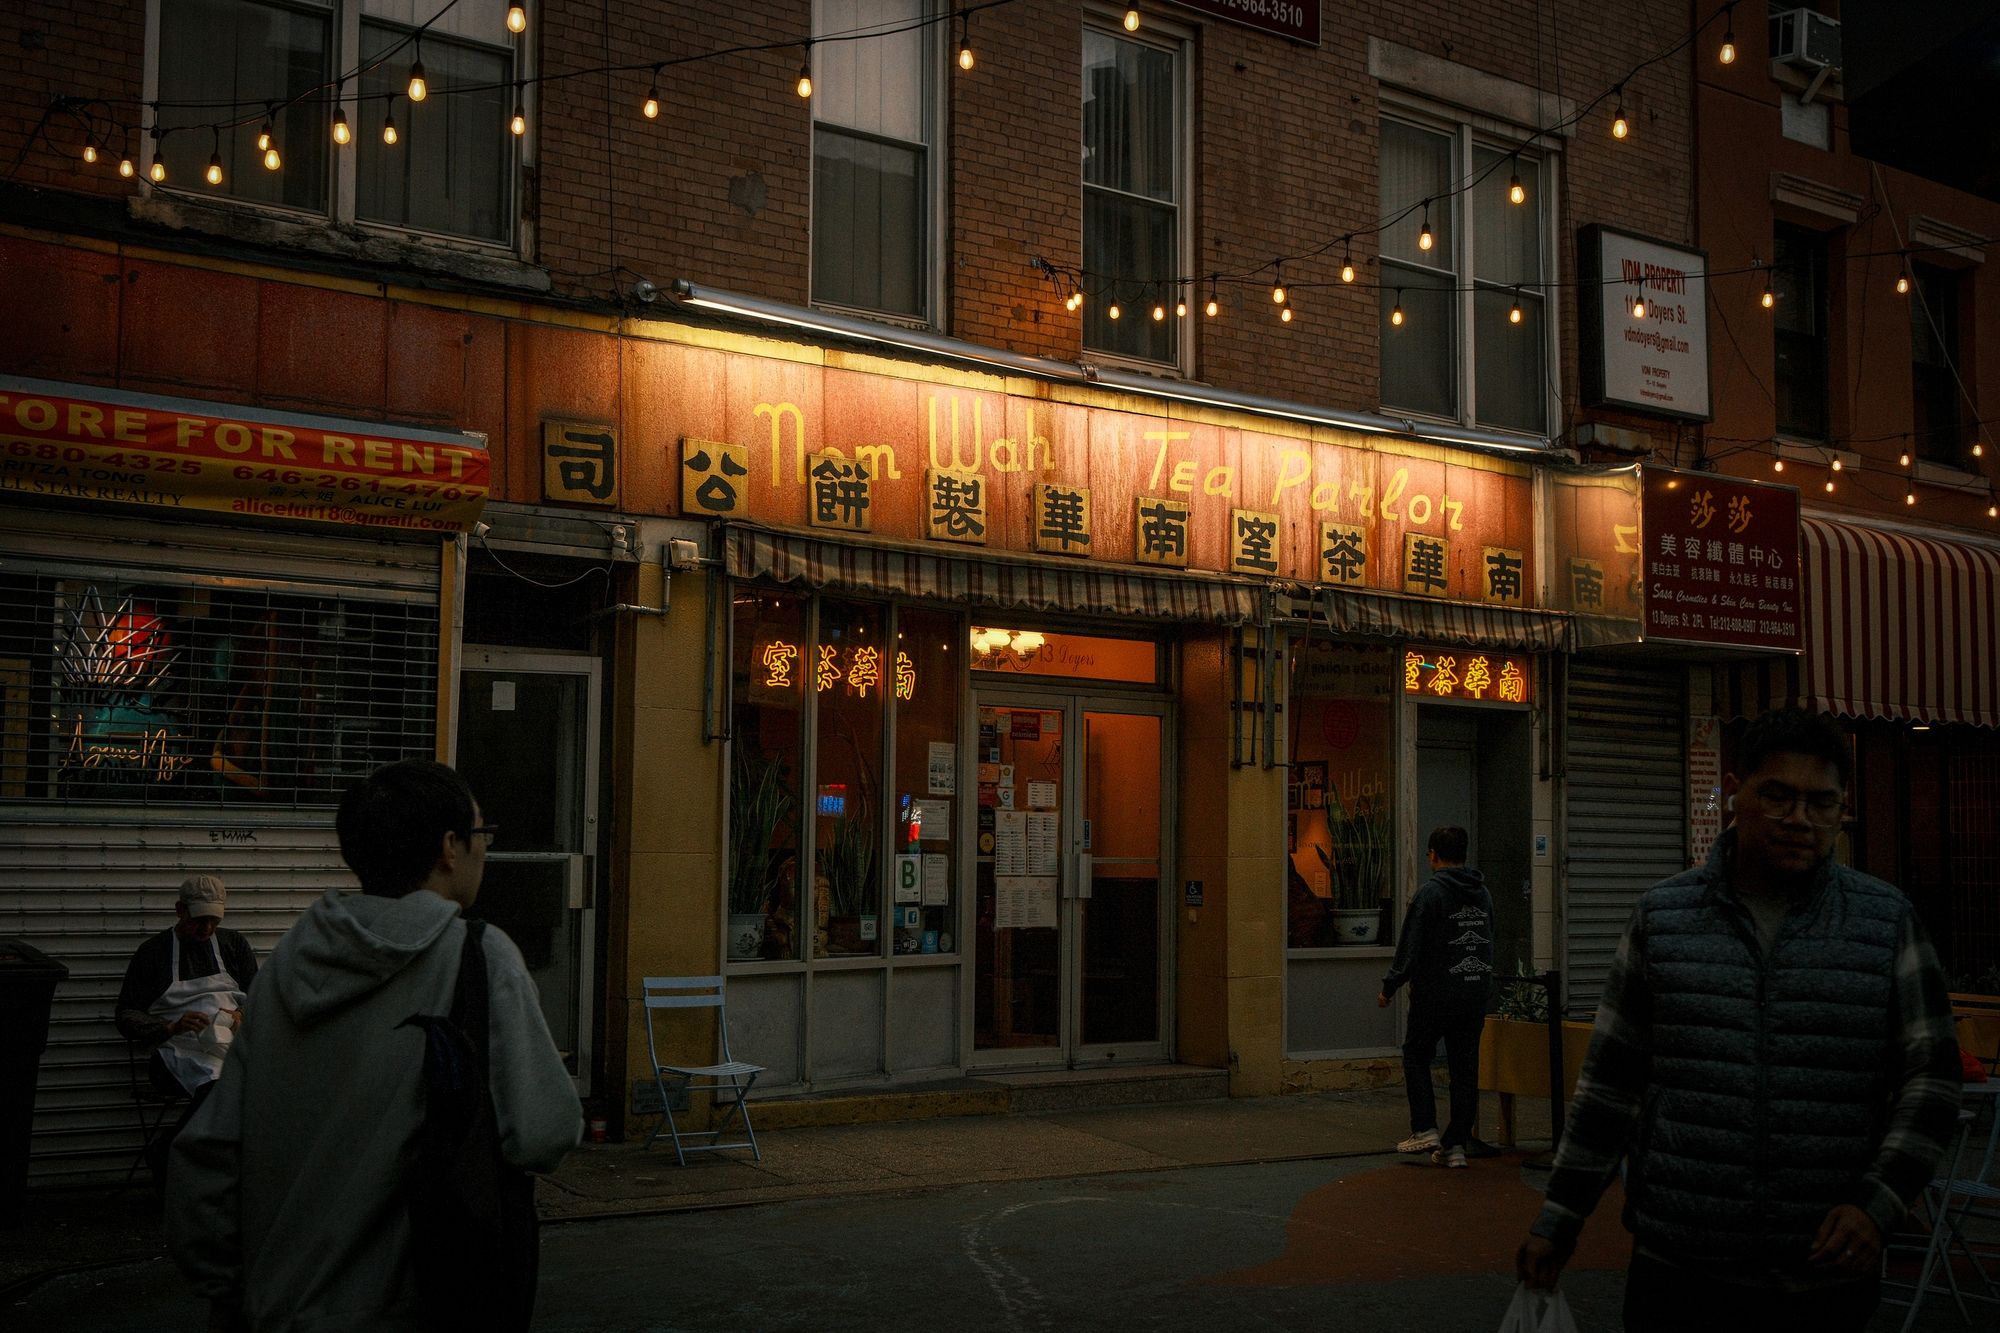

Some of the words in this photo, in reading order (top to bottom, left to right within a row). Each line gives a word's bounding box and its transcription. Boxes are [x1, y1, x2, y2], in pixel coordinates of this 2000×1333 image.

[1622, 258, 1641, 286] VDM
[1644, 263, 1686, 296] PROPERTY
[1649, 299, 1675, 325] Doyers
[1677, 305, 1688, 325] St.
[0, 396, 148, 443] ORE
[177, 417, 298, 461] FOR
[323, 435, 473, 479] RENT
[0, 459, 70, 477] RITZA
[80, 466, 147, 485] TONG
[929, 396, 1056, 474] Wah
[1143, 431, 1235, 498] Tea
[1271, 450, 1464, 531] Parlor
[34, 479, 94, 498] STAR
[97, 488, 187, 507] REALTY
[232, 466, 485, 503] 646-261-4707
[233, 497, 465, 533] alicelui18@gmail.com
[349, 494, 406, 510] ALICE
[411, 500, 443, 512] LUI
[1652, 582, 1675, 600] Sasa
[1676, 590, 1708, 604] Cosmetics
[1711, 594, 1718, 605] &
[1720, 595, 1737, 607] Skin
[1739, 597, 1756, 609] Care
[1758, 599, 1780, 614] Beauty
[1652, 609, 1660, 625] 13
[1661, 610, 1680, 630] Doyers
[1060, 643, 1095, 673] Doyers
[902, 860, 915, 889] B
